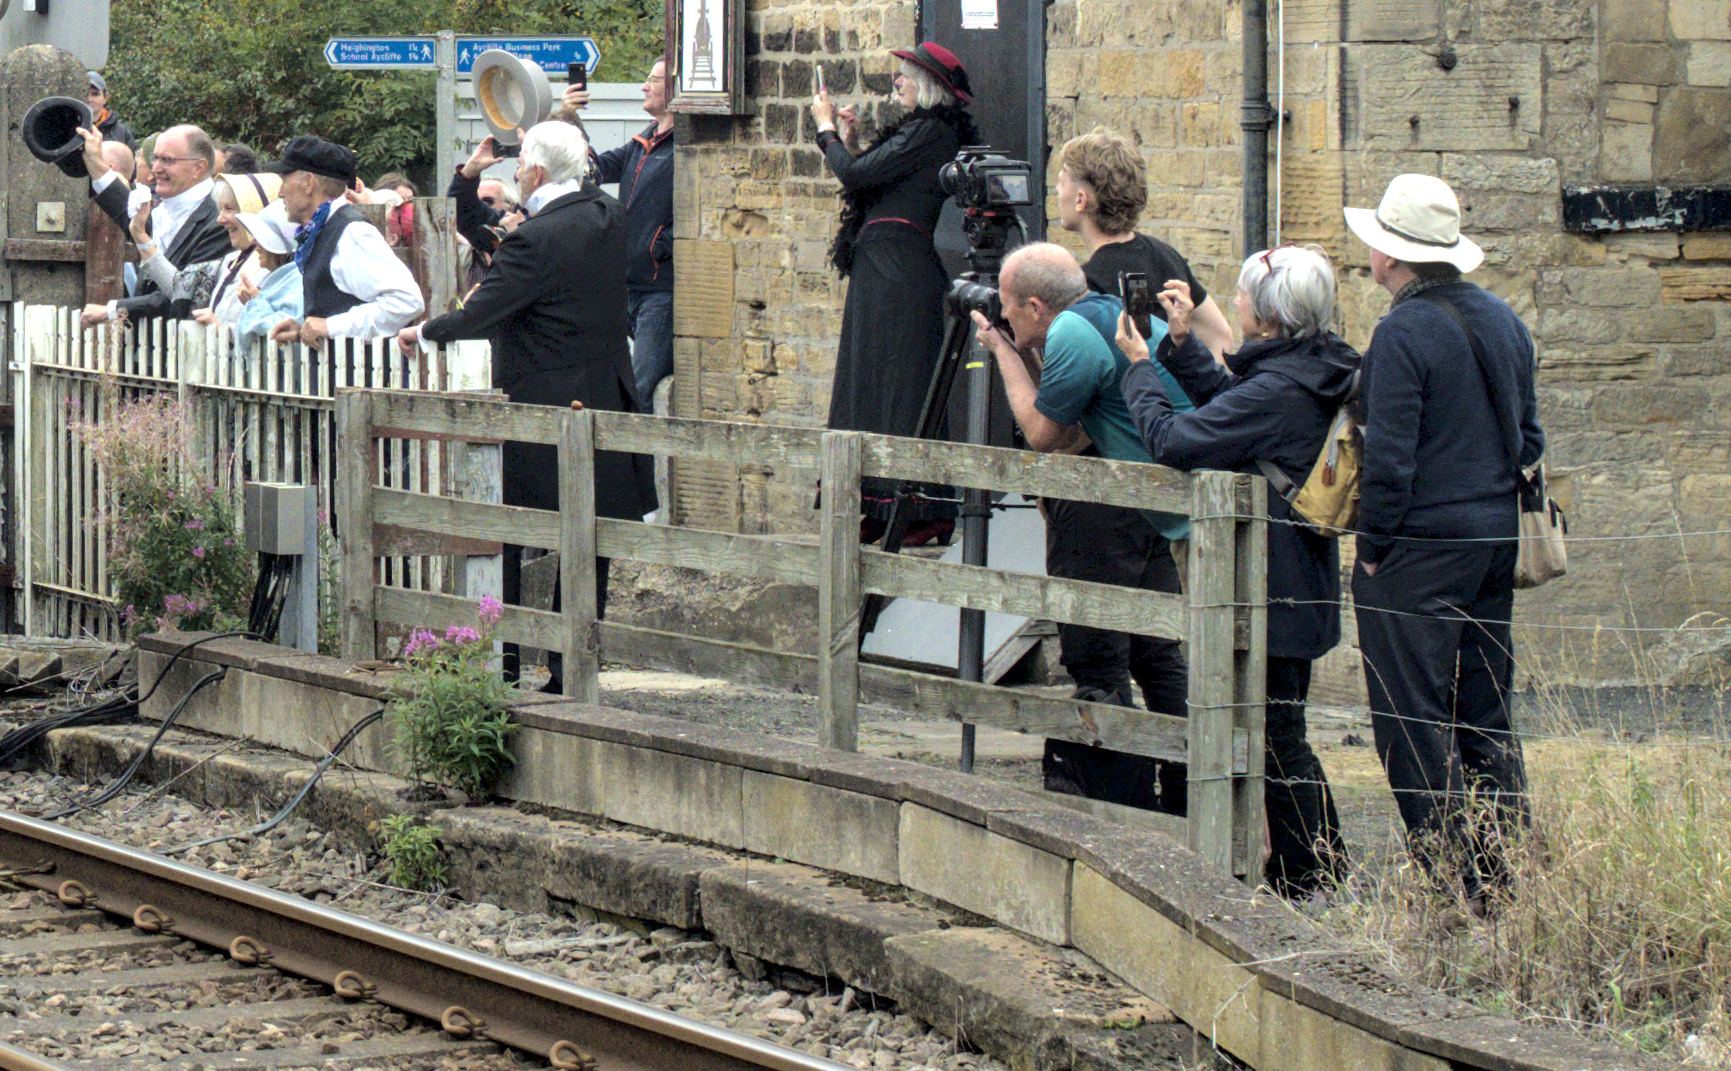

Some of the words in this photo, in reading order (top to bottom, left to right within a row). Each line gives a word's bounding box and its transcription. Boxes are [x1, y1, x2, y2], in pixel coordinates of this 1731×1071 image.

[341, 43, 390, 52] Heighington
[473, 43, 503, 51] Aycliffe
[505, 43, 540, 51] Business
[543, 43, 561, 51] Park
[341, 52, 368, 61] School
[371, 52, 401, 63] Aycliffe
[539, 61, 567, 70] Centre
